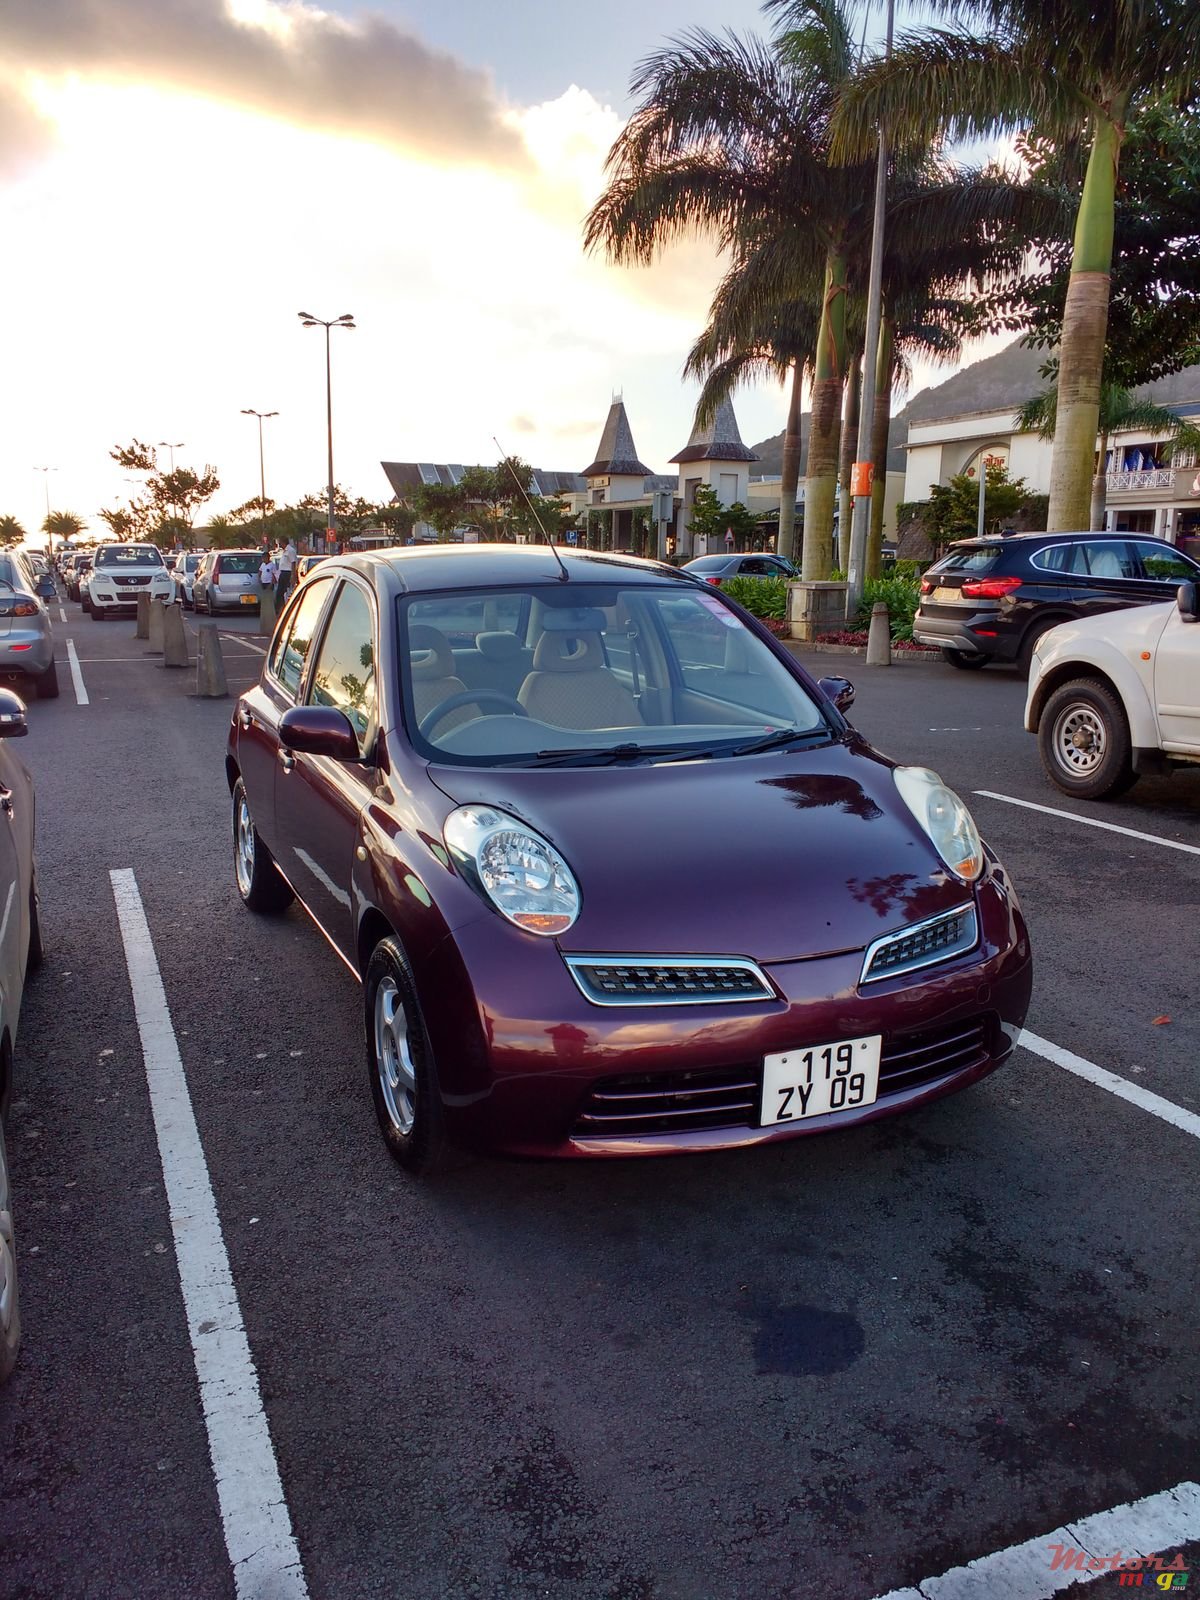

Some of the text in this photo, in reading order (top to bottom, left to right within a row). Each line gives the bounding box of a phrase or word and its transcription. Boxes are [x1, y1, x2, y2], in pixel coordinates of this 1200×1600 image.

[802, 1044, 852, 1083] 119
[777, 1073, 865, 1120] ZY 09
